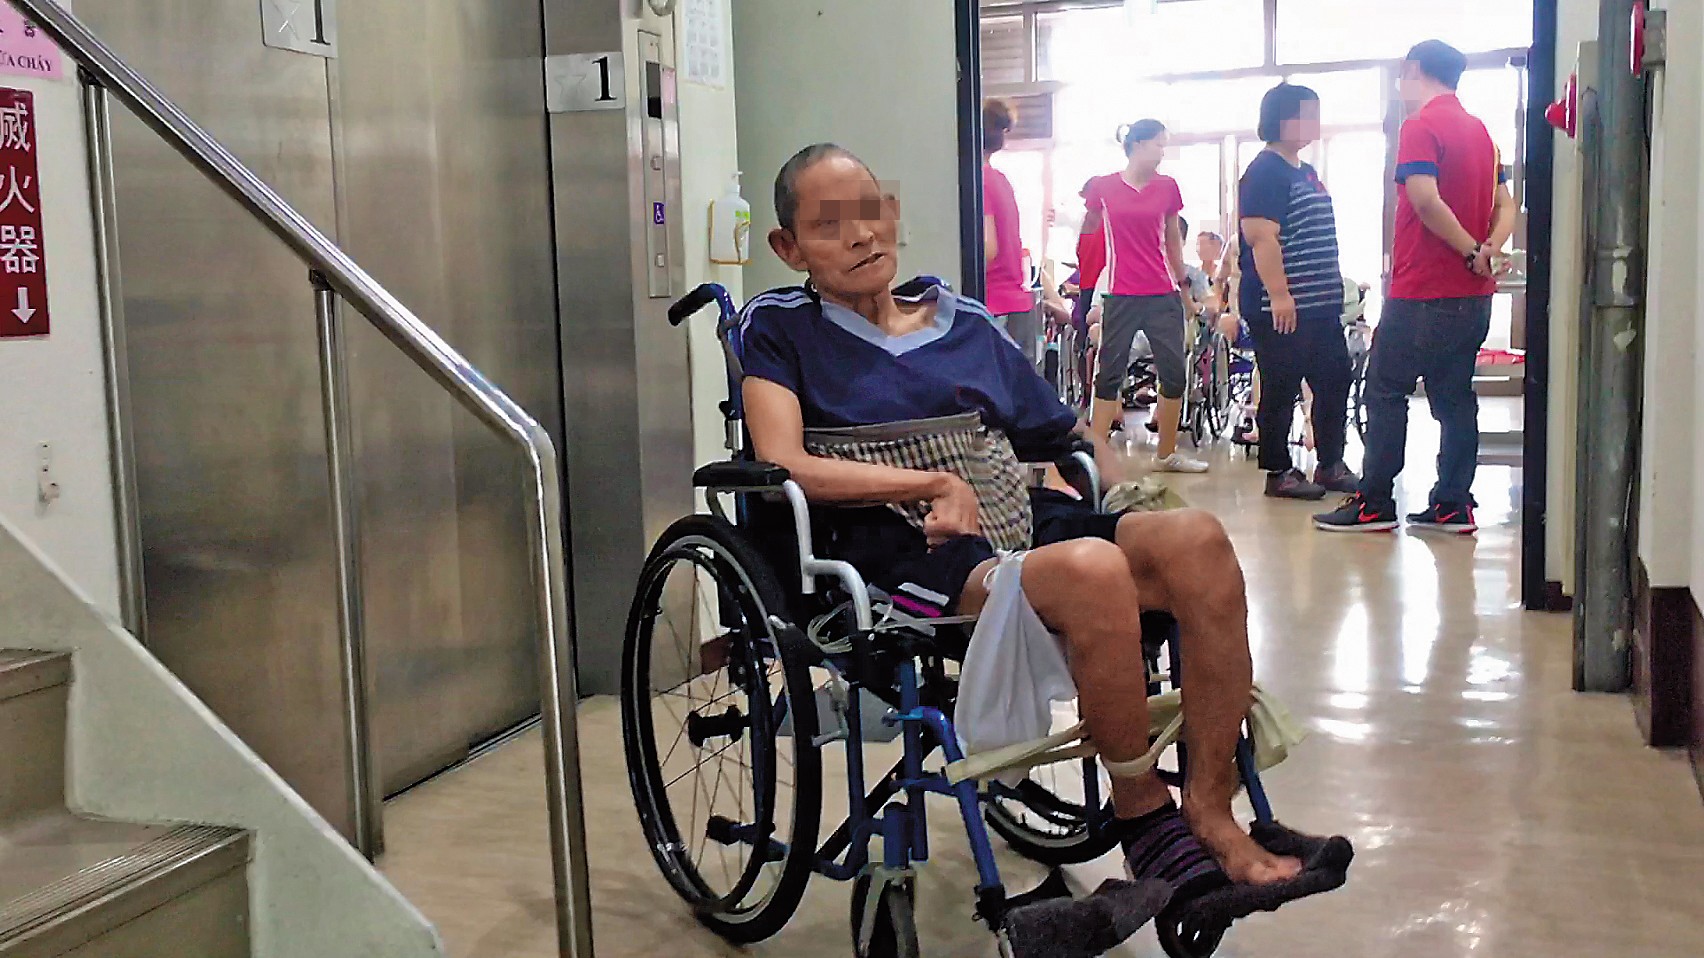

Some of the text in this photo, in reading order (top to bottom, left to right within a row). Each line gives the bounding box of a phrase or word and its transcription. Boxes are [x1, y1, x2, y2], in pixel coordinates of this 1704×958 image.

[592, 56, 617, 101] 1
[0, 101, 39, 274] 滅火器
